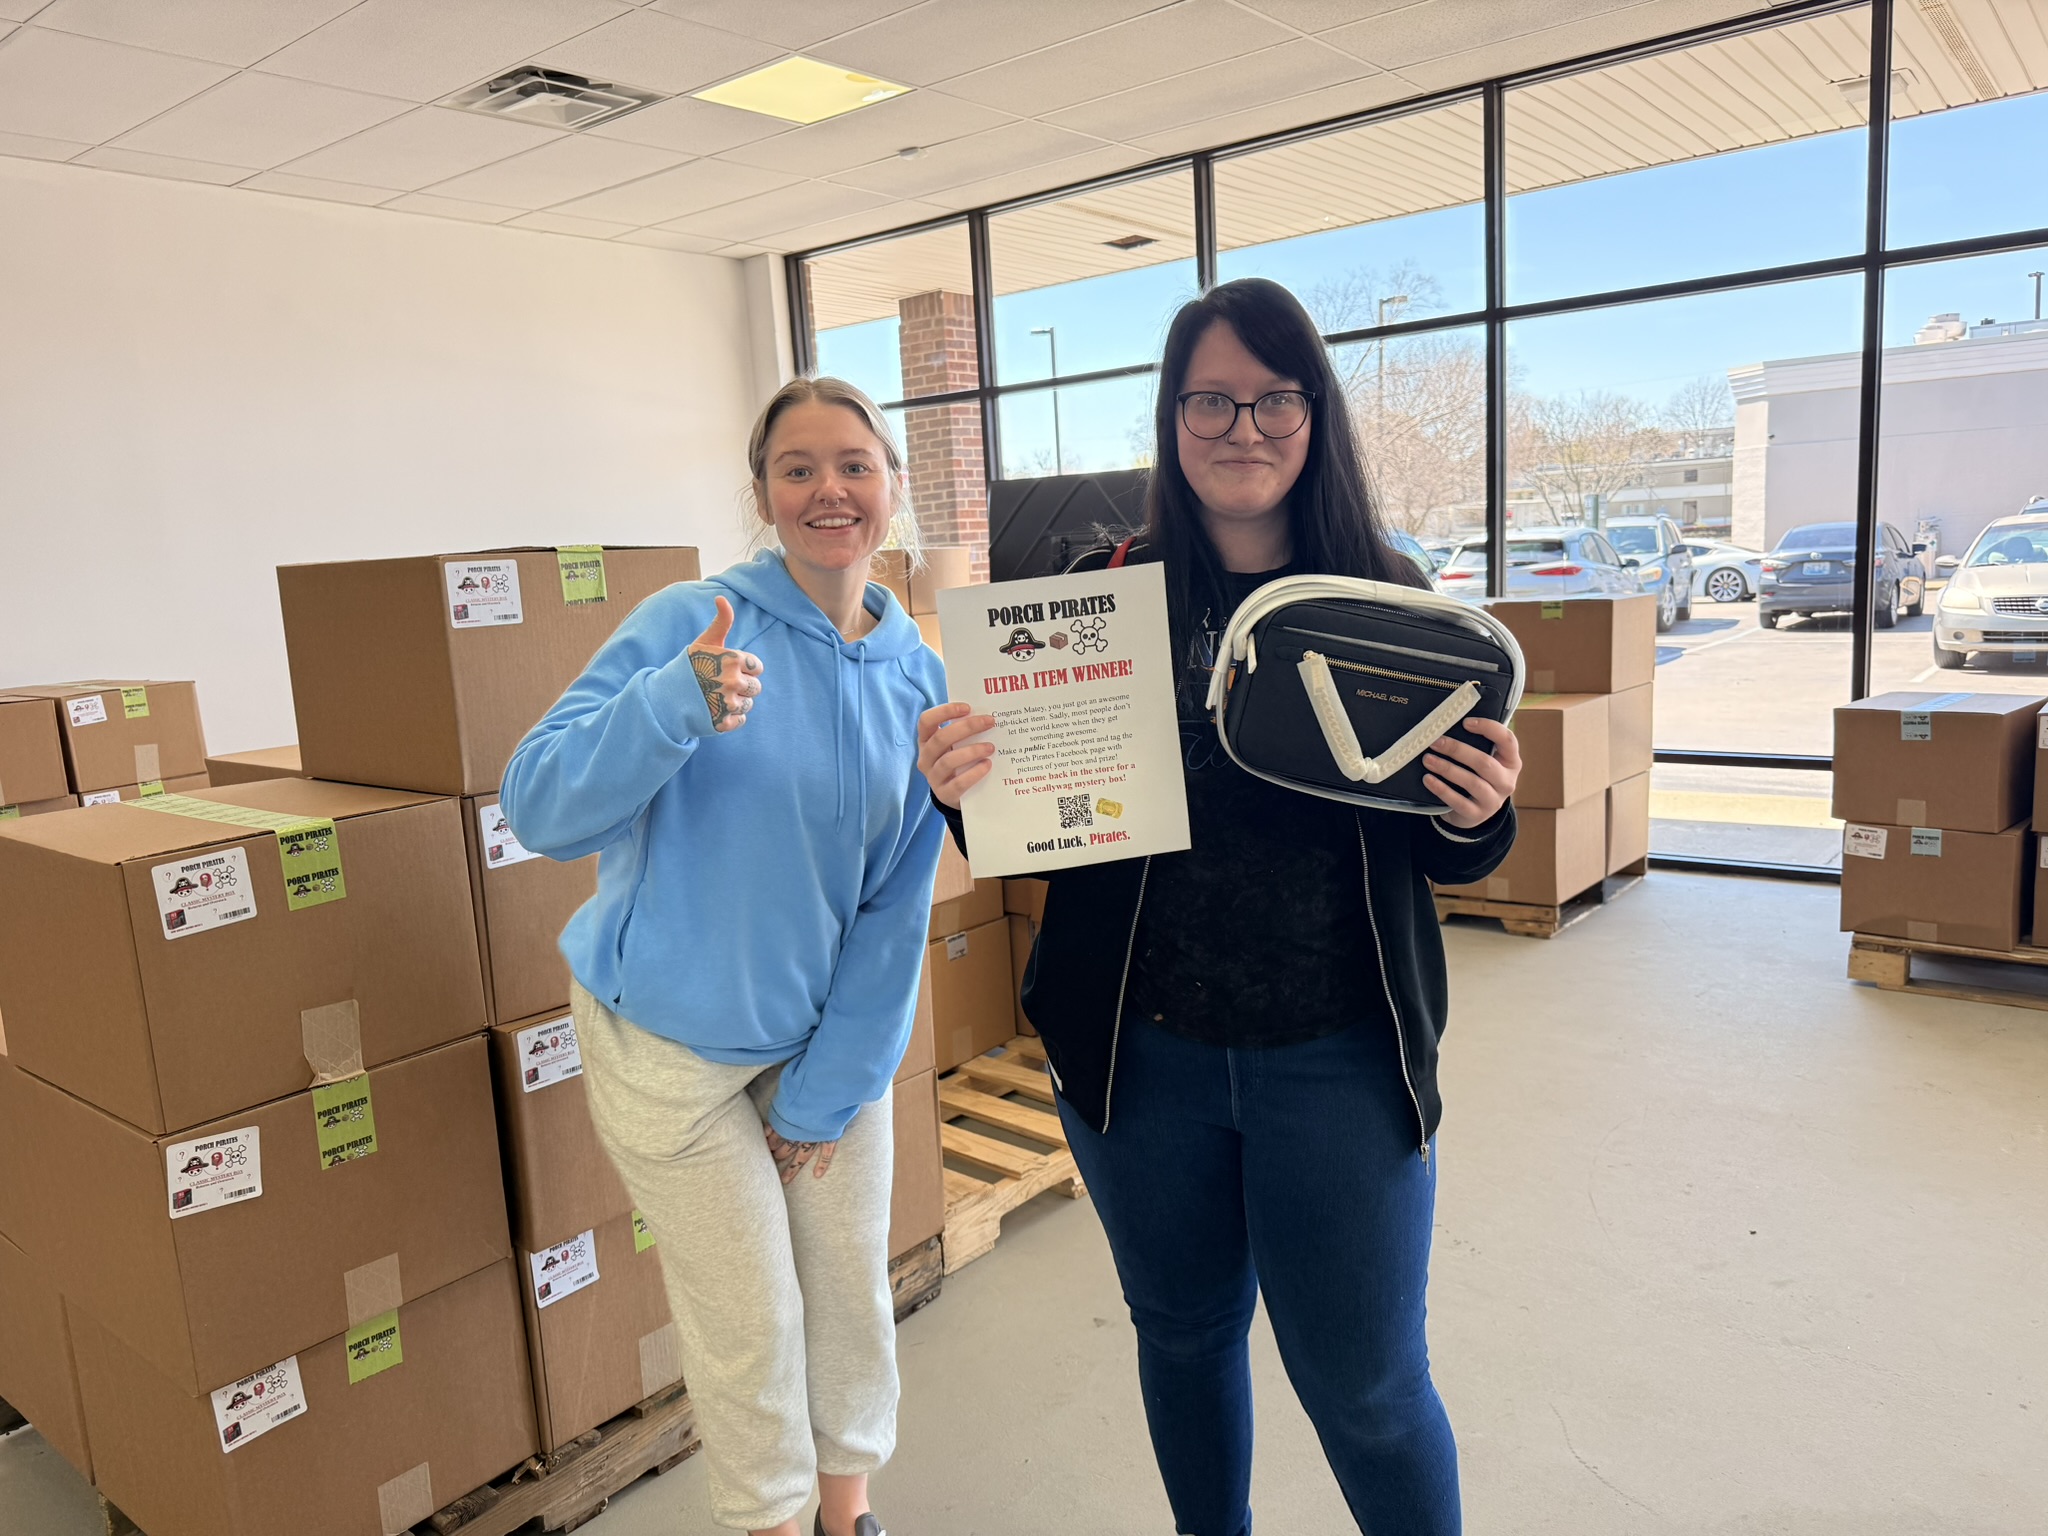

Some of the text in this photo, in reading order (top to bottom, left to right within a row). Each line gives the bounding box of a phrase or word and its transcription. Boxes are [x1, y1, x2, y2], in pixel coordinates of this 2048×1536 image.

[987, 594, 1116, 627] PORCH PIRATES
[984, 659, 1133, 694] ULTRA ITEM WINNER!
[992, 709, 1022, 718] Congrats
[1062, 701, 1075, 709] just
[1099, 694, 1130, 703] awesome
[1356, 689, 1409, 704] MICHAEL KORS
[1049, 711, 1070, 720] Sadly,
[1089, 706, 1112, 715] people
[1030, 724, 1050, 732] world
[1108, 715, 1118, 723] get
[1030, 731, 1064, 741] something
[998, 748, 1017, 756] Make
[1024, 744, 1045, 754] public
[1047, 739, 1079, 749] Facebook
[1081, 737, 1095, 746] post
[1010, 756, 1030, 764] Porch
[1032, 753, 1054, 761] Pirates
[1056, 748, 1088, 758] Facebook
[1090, 746, 1106, 755] page
[1017, 765, 1043, 775] pictures
[1085, 756, 1098, 764] and
[1099, 753, 1118, 764] prize!
[1002, 778, 1024, 786] Then
[1026, 775, 1047, 783] come
[1049, 771, 1068, 780] back
[1014, 774, 1127, 796] free Scallywag mystery box!
[280, 827, 333, 845] PORCH PIRATES
[1027, 830, 1131, 853] Good Luck, Pirates.
[181, 857, 225, 873] PORCH PIRATES
[287, 867, 339, 887] PORCH PIRATES
[318, 1096, 368, 1119] PORCH PIRATES
[195, 1136, 239, 1152] PORCH PIRATES
[322, 1135, 373, 1159] PORCH PIRATES
[349, 1326, 396, 1352] PORCH PIRATES
